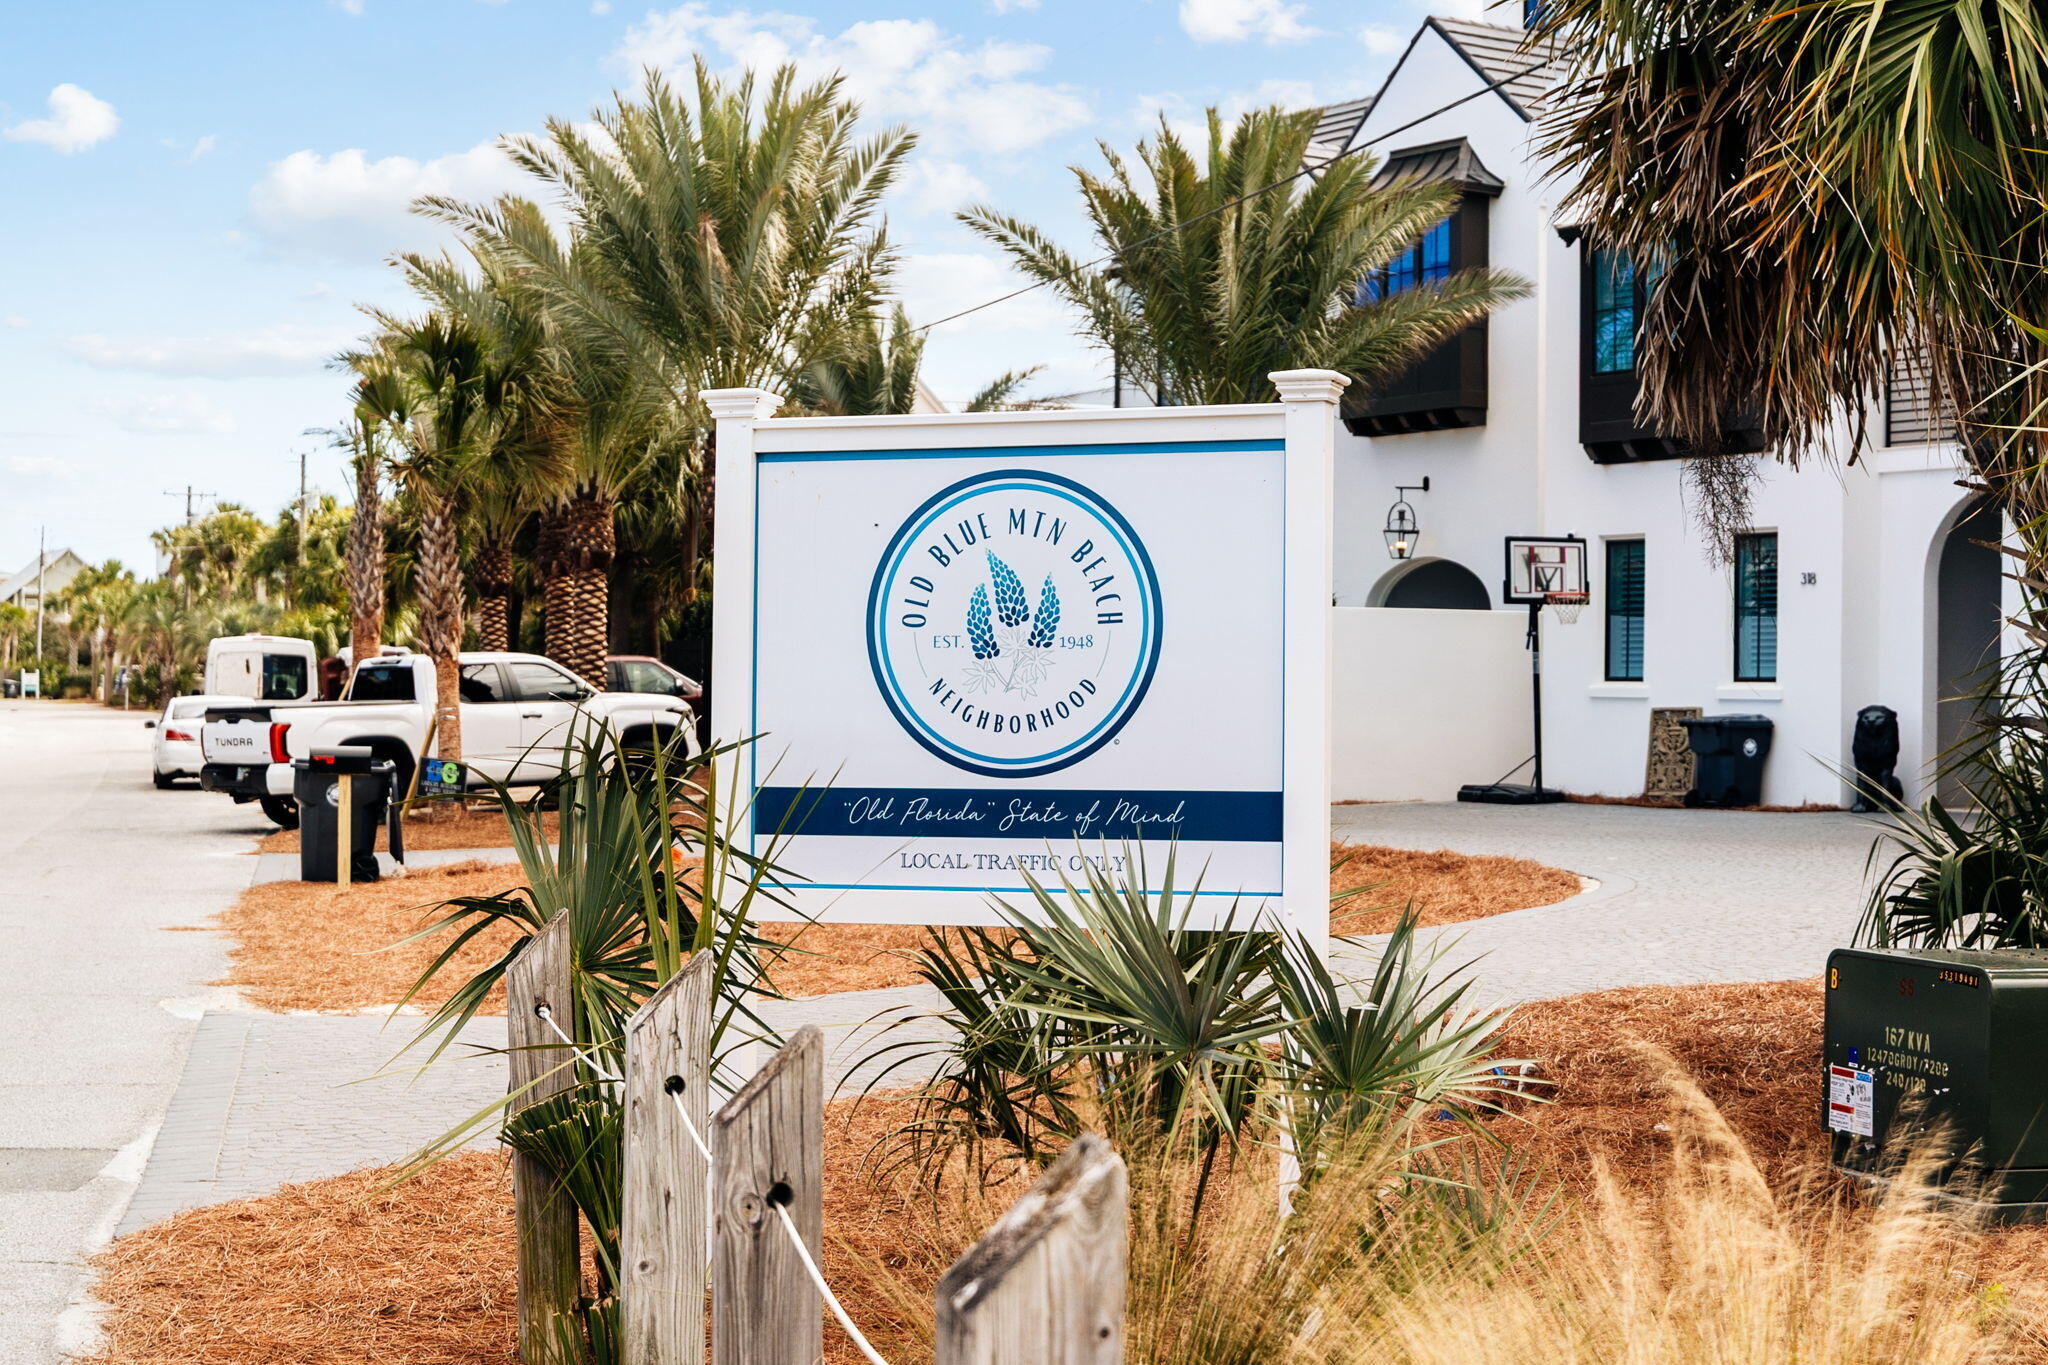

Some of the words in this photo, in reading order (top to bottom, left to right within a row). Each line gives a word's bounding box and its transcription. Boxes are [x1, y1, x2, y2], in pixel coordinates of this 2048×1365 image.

[901, 575, 934, 628] OLD
[928, 513, 992, 567] BLUE
[1008, 508, 1067, 546] MTN
[1070, 539, 1124, 625] BEACH
[1800, 572, 1817, 585] 318
[932, 635, 965, 649] EST.
[1059, 634, 1094, 650] 1948
[928, 678, 1097, 734] NEIGHBORHOOD
[215, 737, 254, 747] TUNDRA
[999, 798, 1069, 832] State
[1075, 800, 1100, 835] of
[1105, 798, 1186, 826] Mind
[900, 853, 968, 870] LOCAL
[973, 853, 1062, 872] TRAFFIC
[1068, 855, 1127, 872] ONLY
[1830, 967, 1839, 989] B
[1884, 1026, 1905, 1048] 167
[1907, 1030, 1931, 1054] KVA
